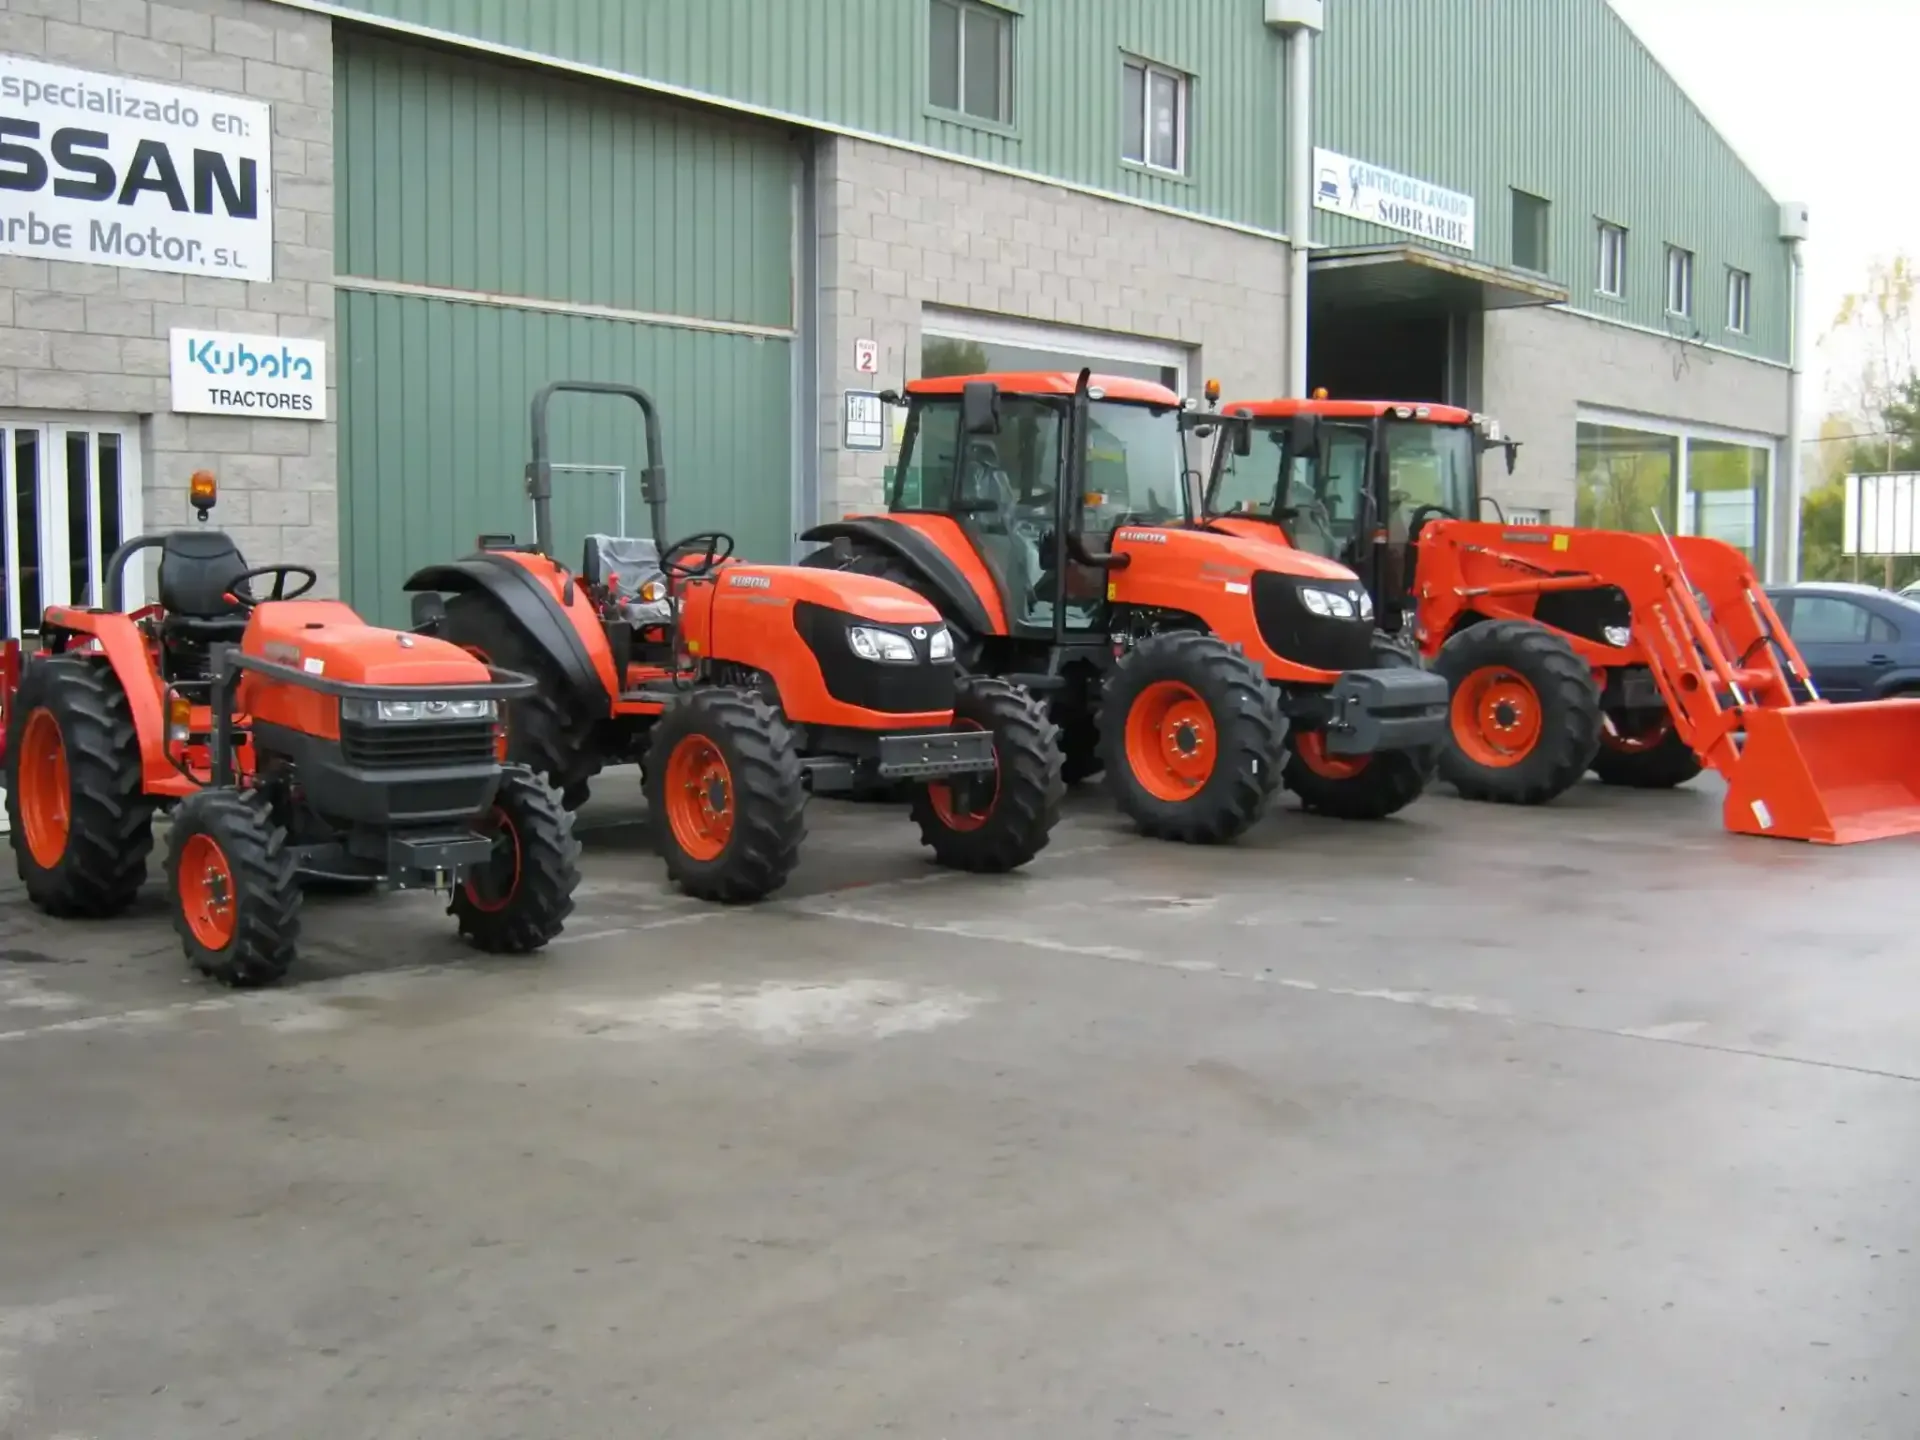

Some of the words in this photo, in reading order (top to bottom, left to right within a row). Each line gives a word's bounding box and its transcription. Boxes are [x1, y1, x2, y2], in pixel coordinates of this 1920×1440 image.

[1, 76, 199, 128] specializado
[211, 112, 250, 137] en:
[1349, 164, 1401, 197] CENTRO
[1402, 180, 1420, 203] DE
[1421, 187, 1468, 218] LAVADO
[0, 210, 72, 249] rbe
[188, 338, 312, 380] Kubota
[861, 351, 872, 370] 2
[208, 388, 313, 411] TRACTORES
[1119, 531, 1167, 543] KUBOTA
[730, 575, 771, 589] KUBOTA
